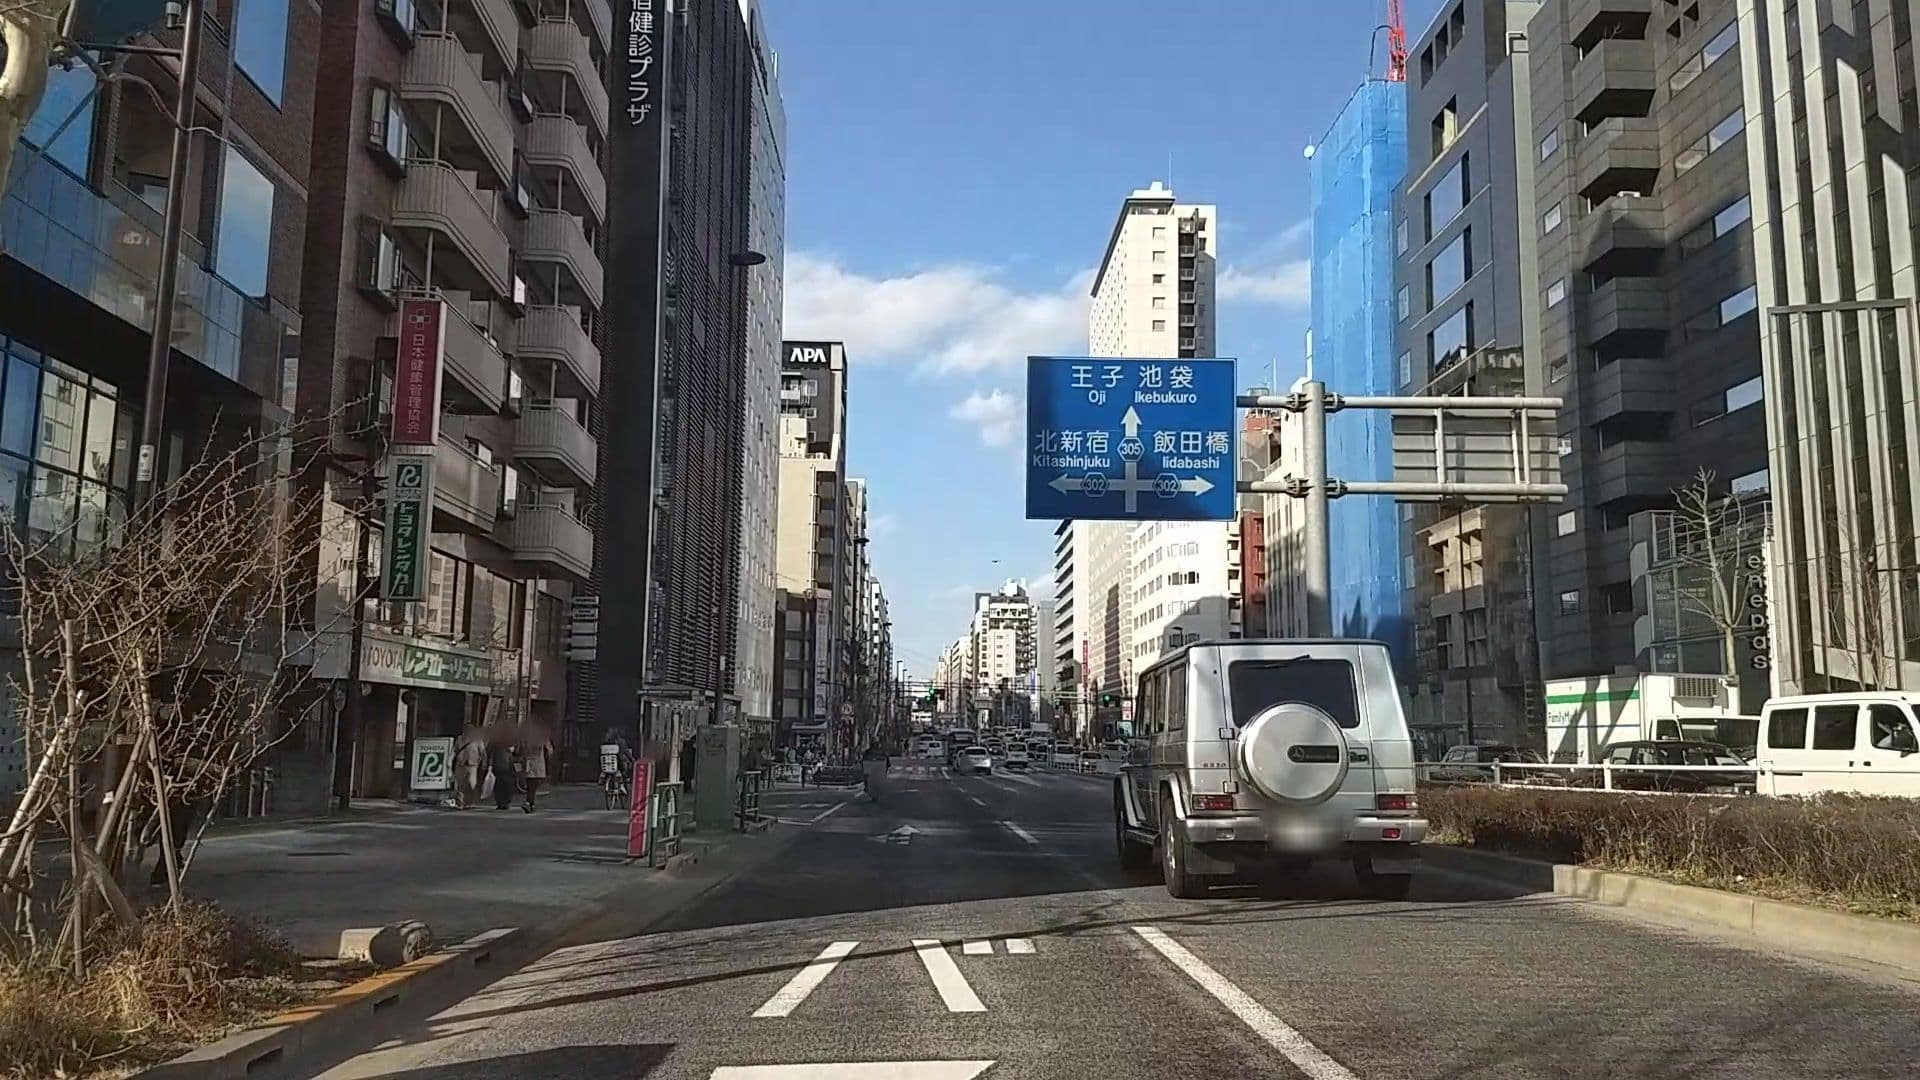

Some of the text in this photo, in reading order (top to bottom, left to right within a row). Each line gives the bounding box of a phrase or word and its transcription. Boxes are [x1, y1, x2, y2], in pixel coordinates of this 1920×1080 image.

[790, 347, 827, 362] APA
[1071, 364, 1193, 388] 王子 池袋
[1088, 390, 1197, 405] Oji Ikebukuro
[1035, 429, 1109, 454] 北新宿
[1153, 430, 1229, 454] 飯田橋
[1121, 443, 1140, 456] 305
[1033, 455, 1110, 470] Kitashinjuku
[1162, 456, 1220, 469] Iidabashi
[1086, 479, 1104, 491] 302
[1158, 479, 1175, 491] 302
[1747, 555, 1769, 669] enepas
